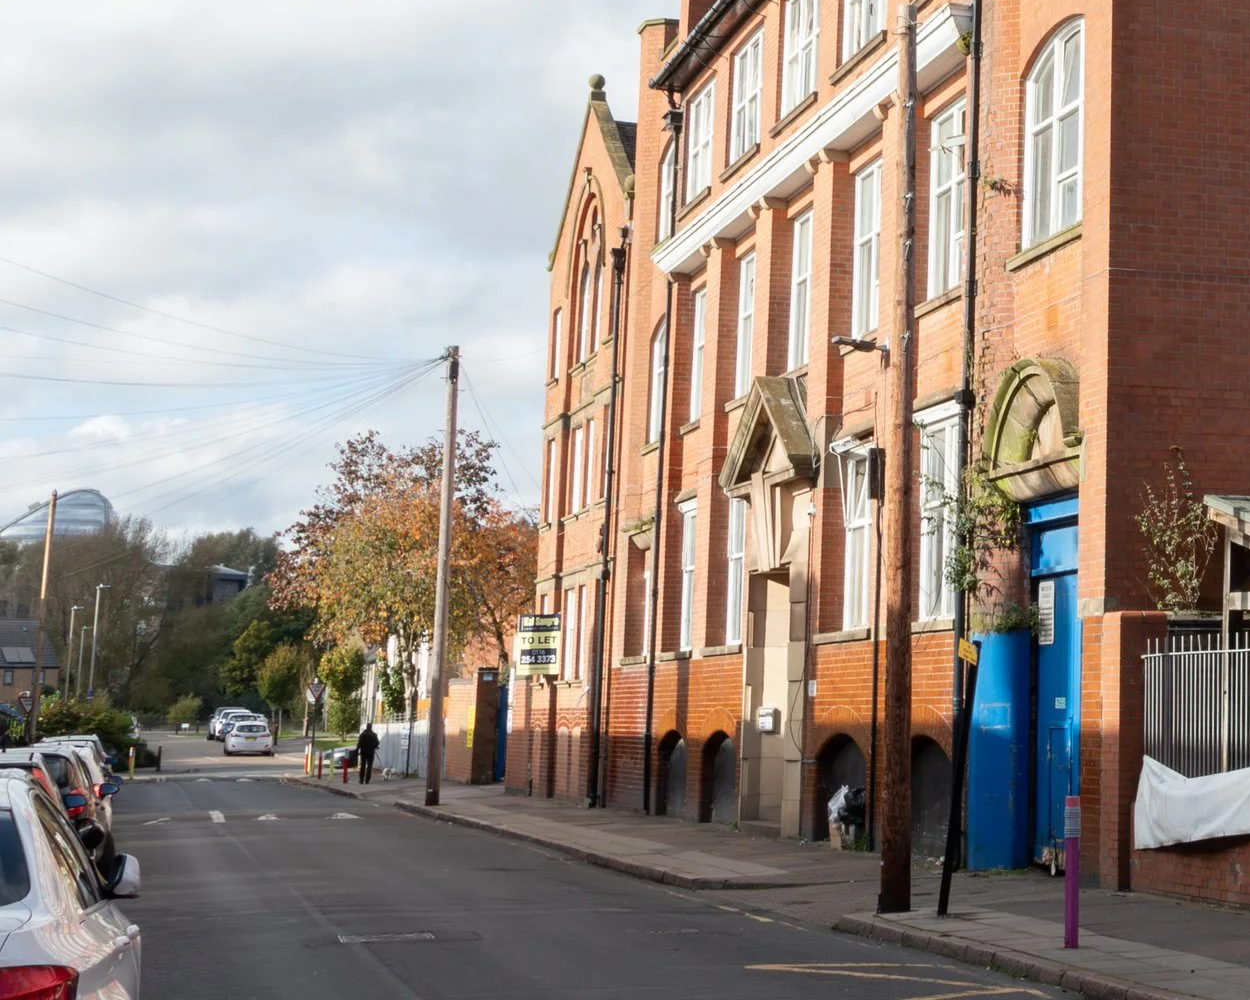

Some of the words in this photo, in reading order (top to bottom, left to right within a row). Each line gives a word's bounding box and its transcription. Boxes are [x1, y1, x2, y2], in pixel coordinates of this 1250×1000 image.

[521, 636, 535, 645] TO
[537, 635, 557, 644] LET
[536, 655, 556, 663] 3373
